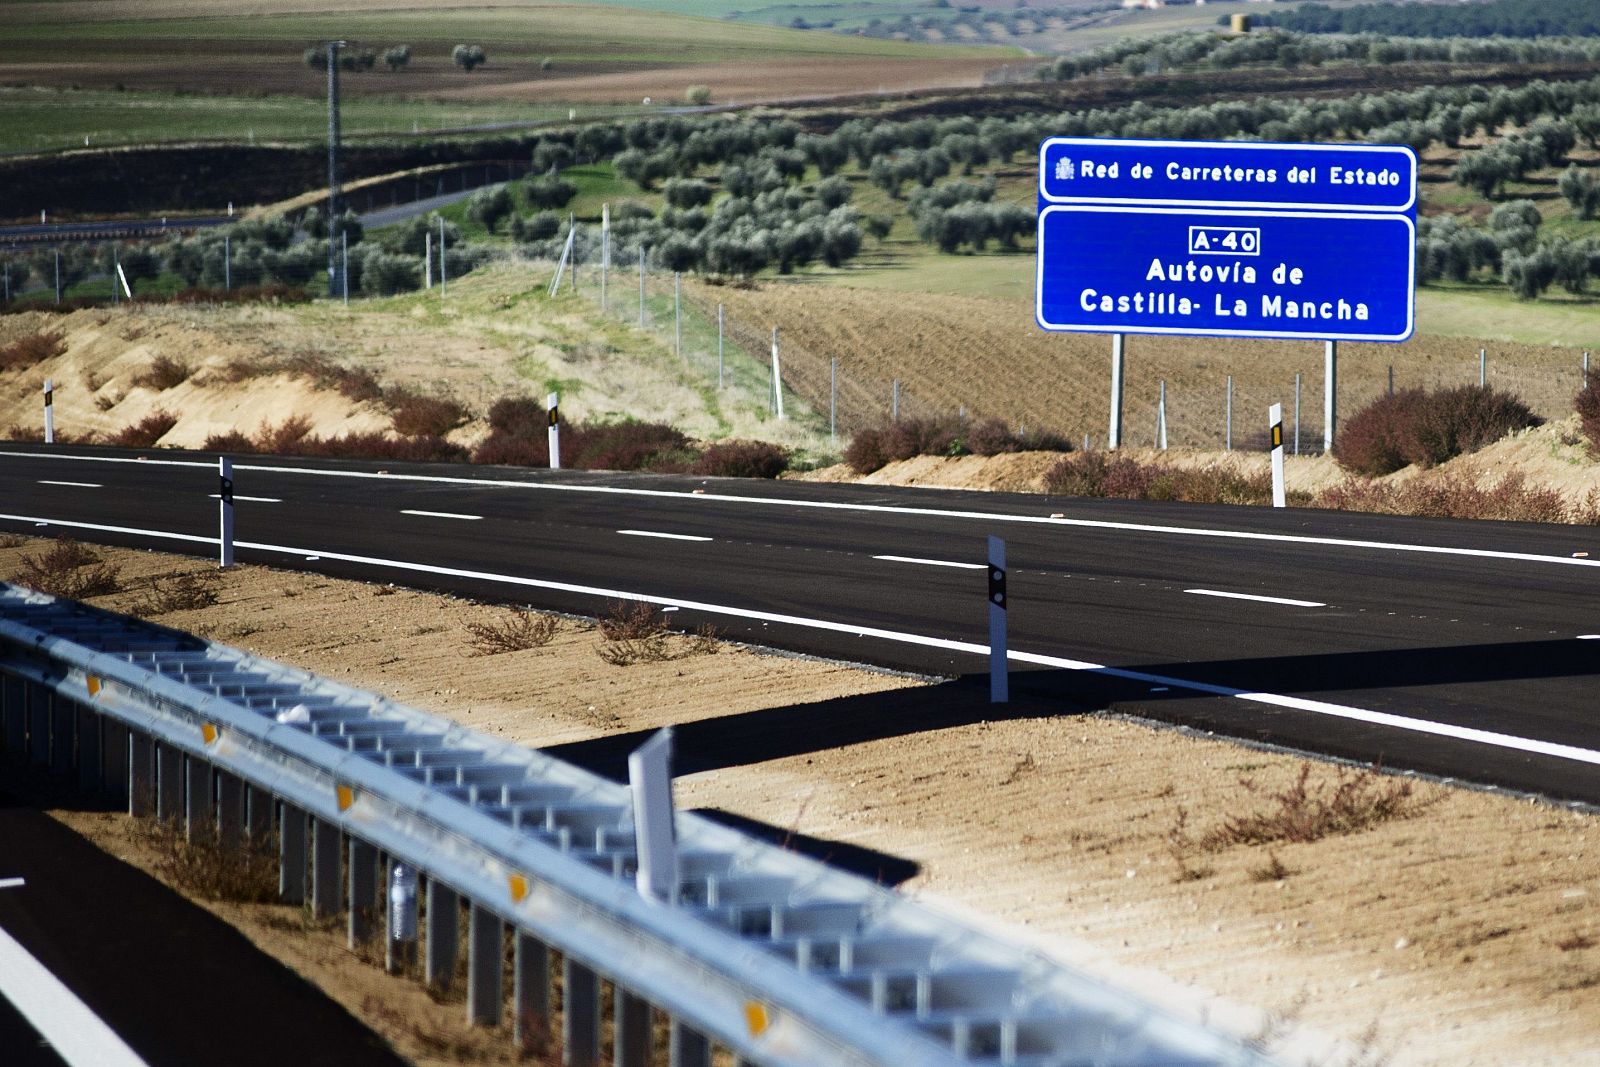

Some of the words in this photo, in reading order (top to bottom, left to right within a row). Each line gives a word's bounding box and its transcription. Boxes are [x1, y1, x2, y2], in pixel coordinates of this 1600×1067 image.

[1081, 160, 1119, 179] Red
[1131, 162, 1153, 180] de
[1166, 161, 1277, 183] Carreteras
[1287, 166, 1316, 184] del
[1330, 166, 1400, 186] Estado
[1193, 230, 1257, 252] A-40
[1145, 258, 1257, 285] Autovía
[1272, 262, 1304, 286] de
[1215, 293, 1247, 317] La
[1261, 294, 1369, 321] Mancha
